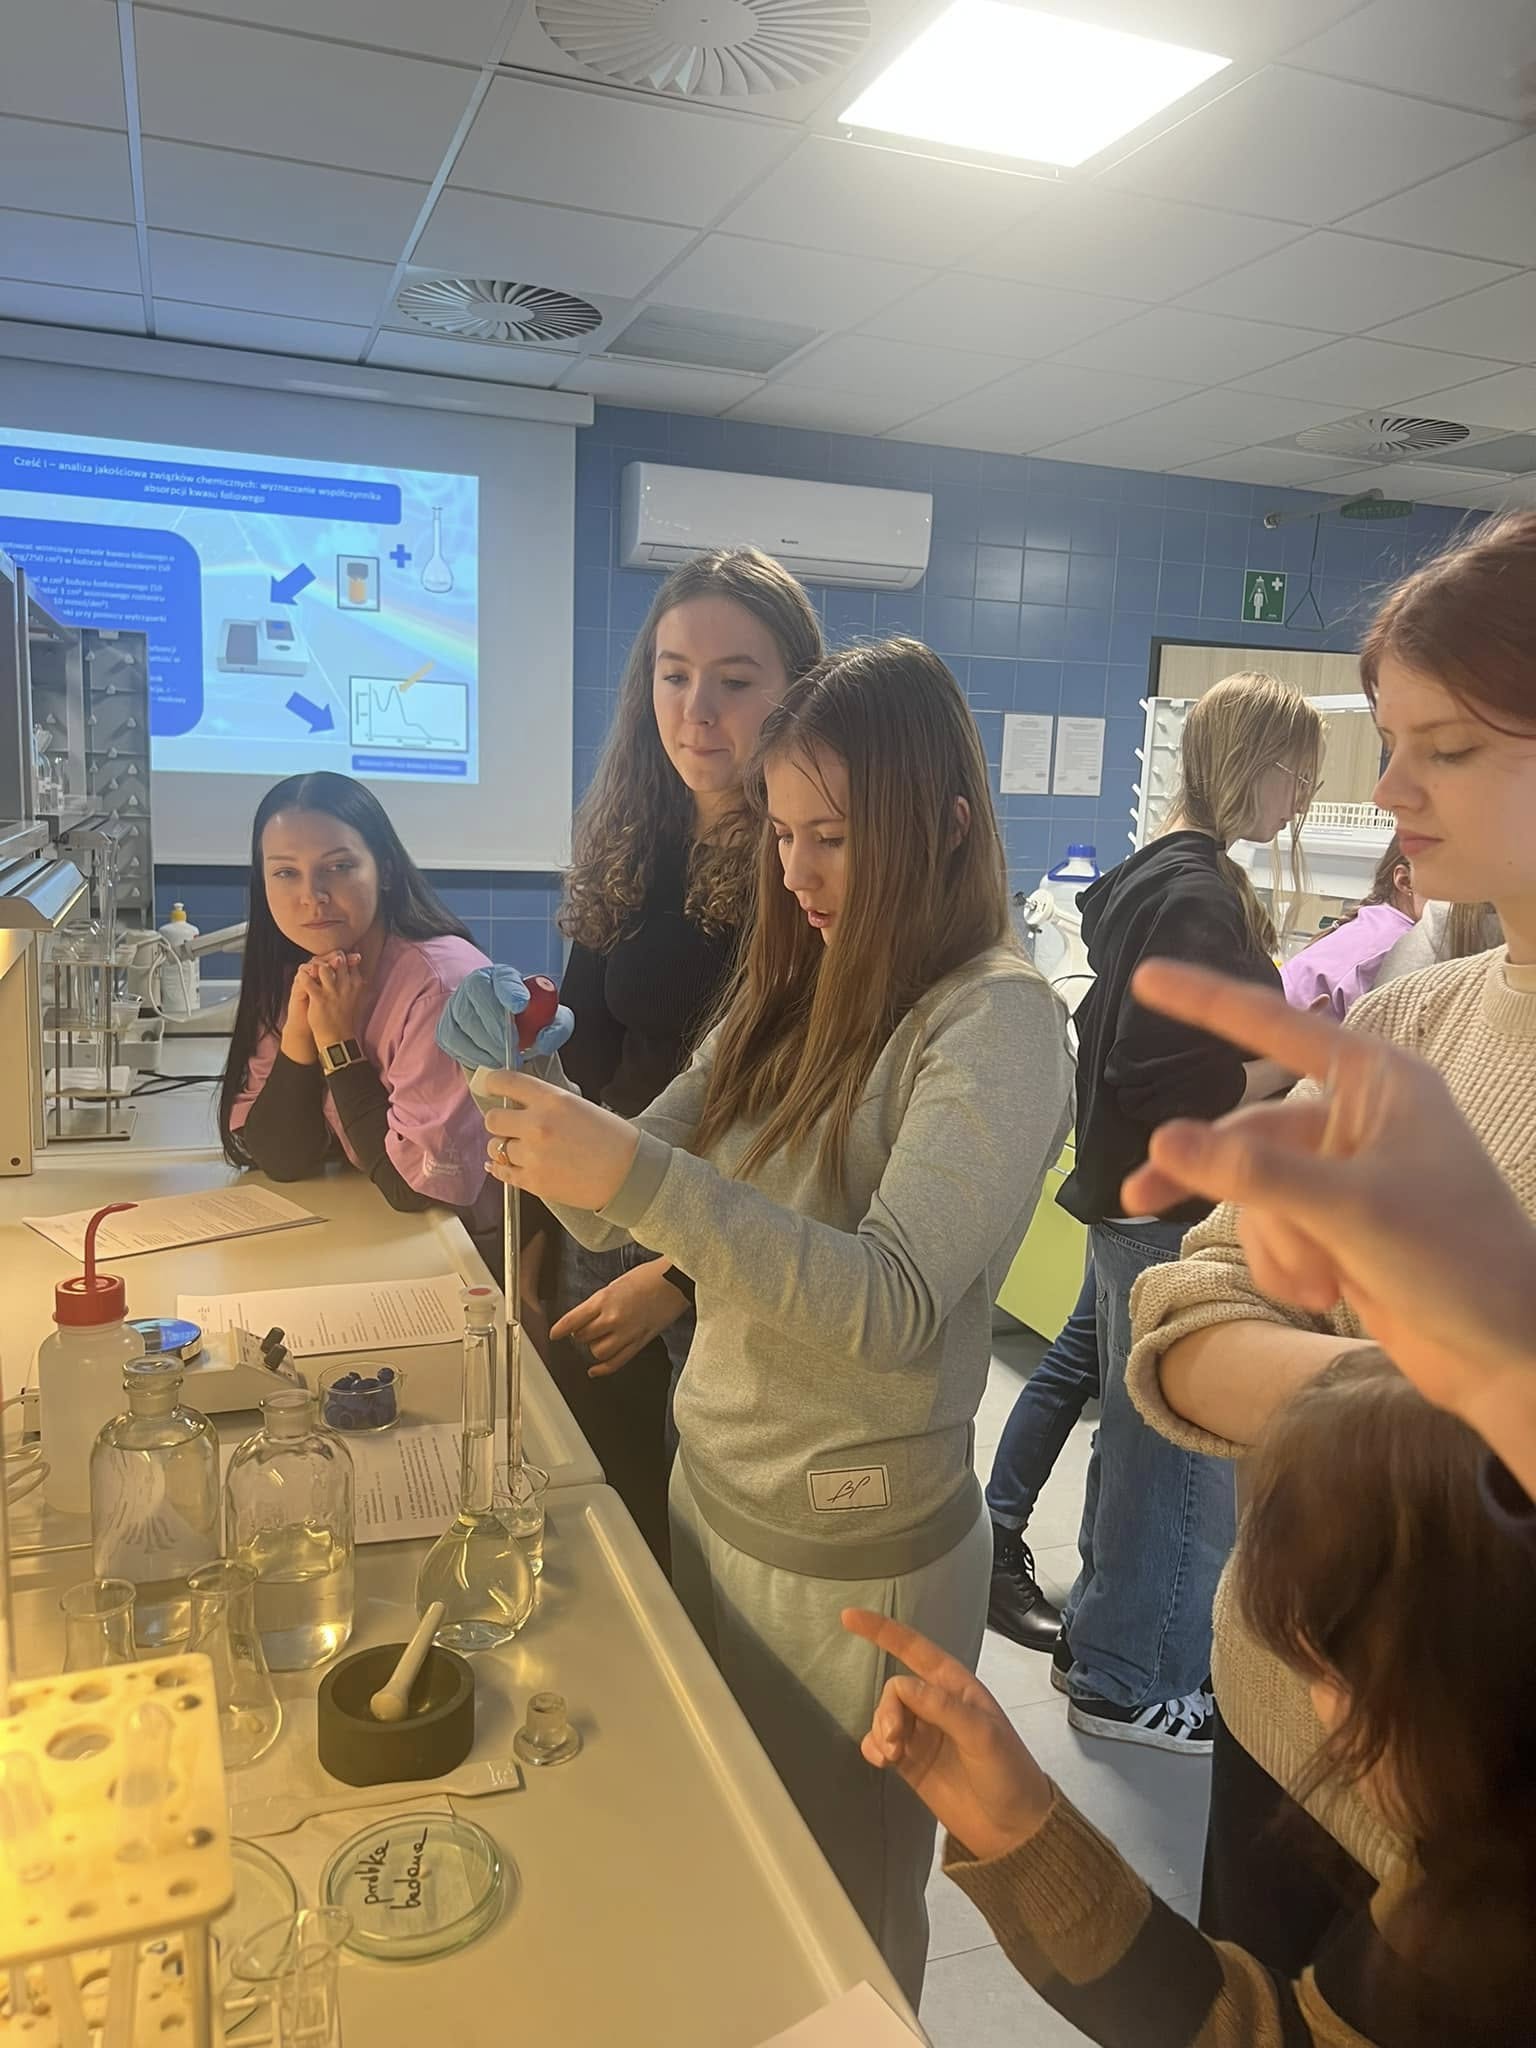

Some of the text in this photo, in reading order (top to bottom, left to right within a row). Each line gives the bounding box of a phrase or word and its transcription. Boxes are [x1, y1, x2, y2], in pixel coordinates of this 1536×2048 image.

[58, 462, 92, 473] analiza
[94, 464, 147, 479] jakościowa
[149, 470, 194, 484] związków
[143, 484, 187, 496] absorpcji
[188, 487, 218, 499] kwasu
